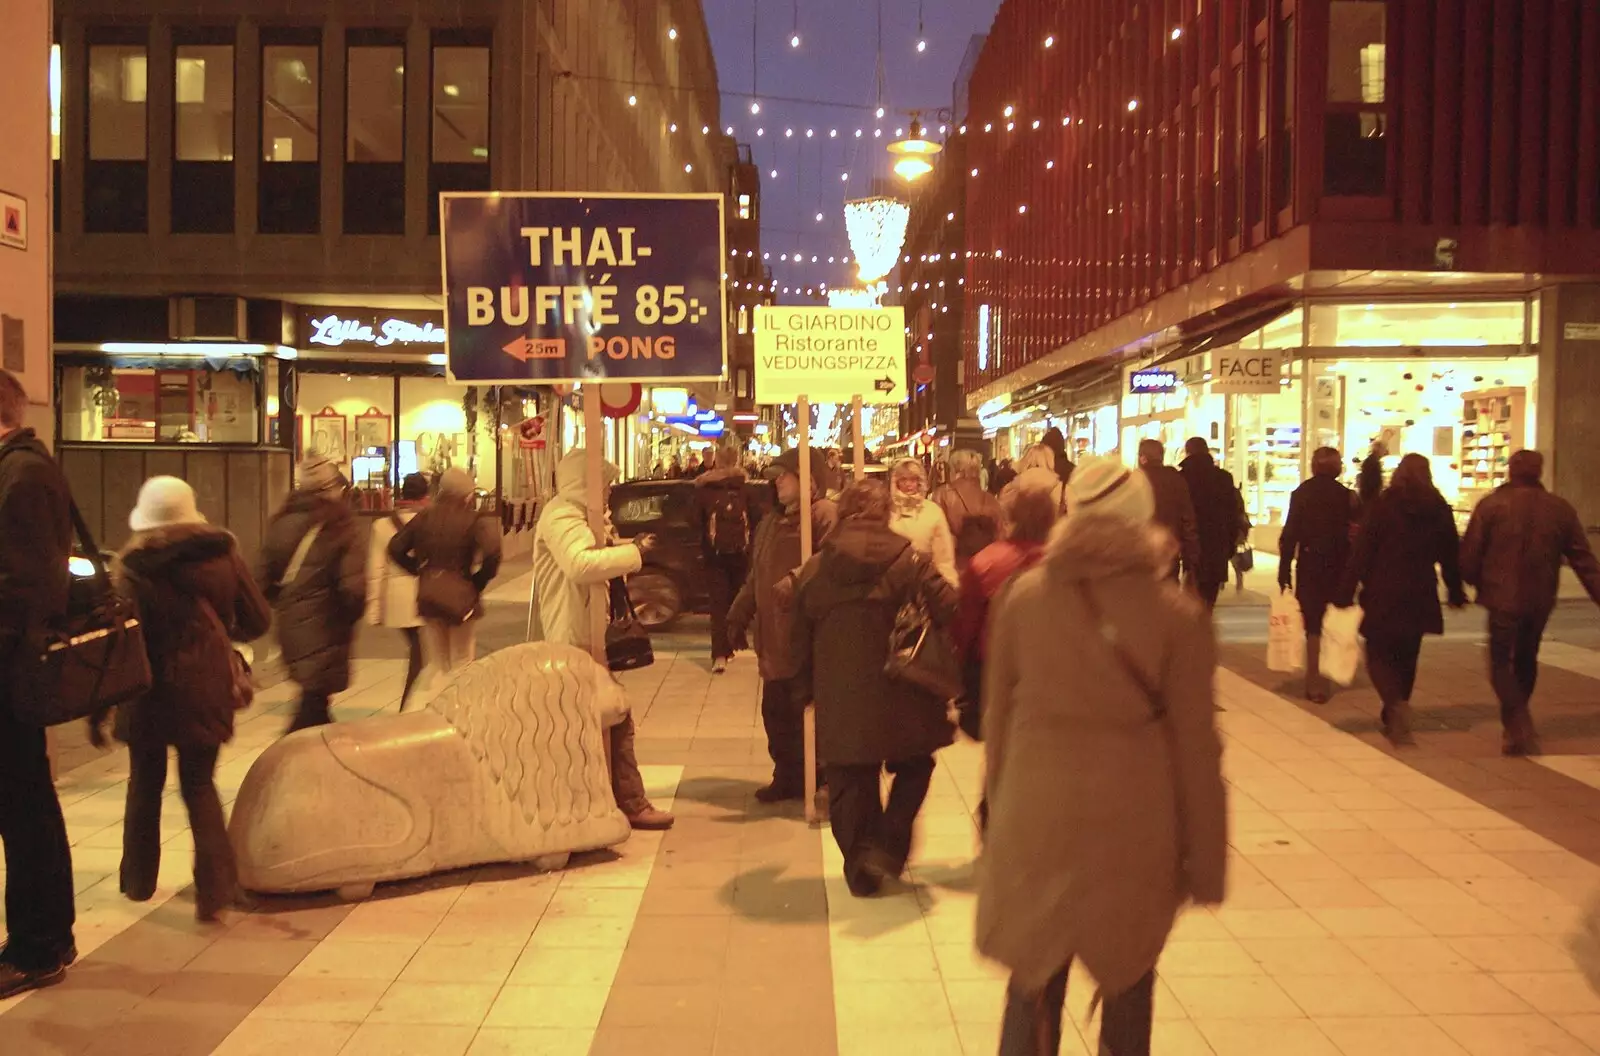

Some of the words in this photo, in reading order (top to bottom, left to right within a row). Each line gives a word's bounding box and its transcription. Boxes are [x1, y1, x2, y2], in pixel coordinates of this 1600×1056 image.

[520, 226, 652, 266] THAI-
[466, 273, 620, 326] BUFFÉ
[634, 284, 708, 325] 85:-
[763, 313, 782, 331] IL
[787, 313, 892, 331] GIARDINO
[525, 341, 559, 355] 25m
[586, 335, 676, 361] PONG
[775, 333, 878, 352] Ristorante
[762, 355, 899, 370] VEDUNGSPIZZA
[1218, 357, 1273, 377] FACE
